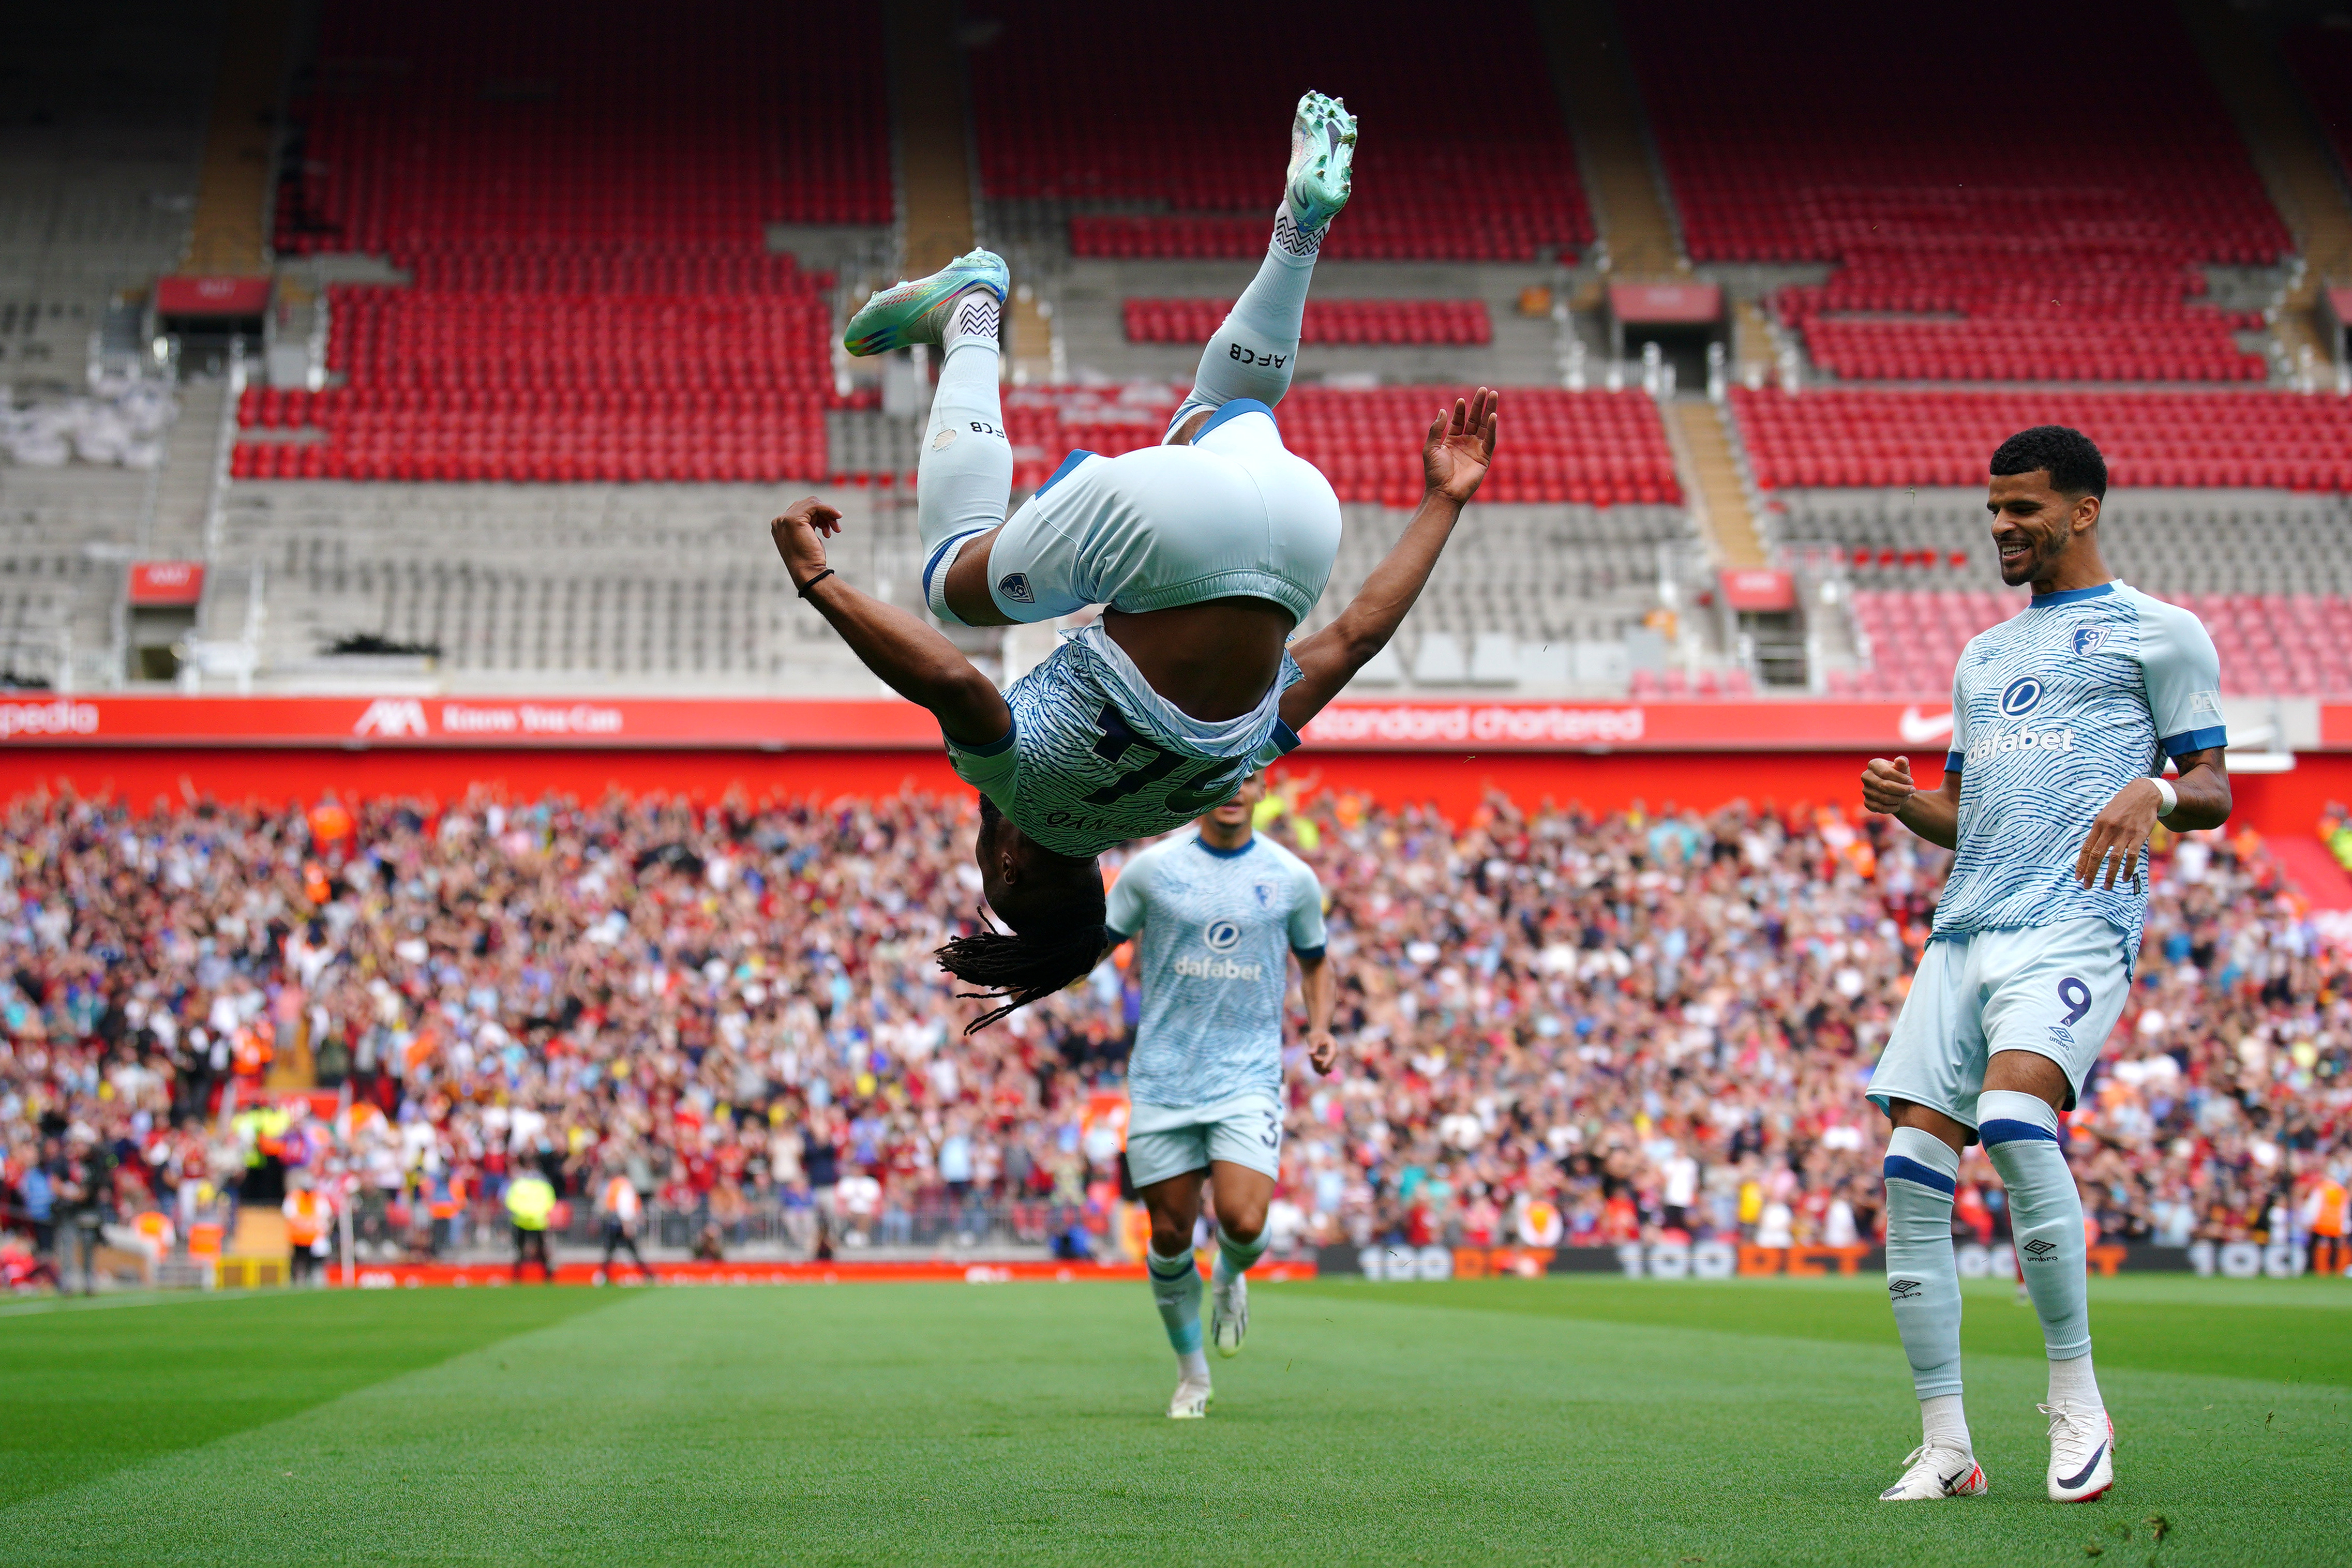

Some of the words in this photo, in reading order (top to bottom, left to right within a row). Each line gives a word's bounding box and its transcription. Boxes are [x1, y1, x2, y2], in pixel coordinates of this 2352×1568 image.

[1230, 343, 1287, 369] AFCB
[1968, 724, 2075, 765] dafabet
[1174, 956, 1262, 981] dafabet
[2057, 977, 2092, 1028] 9
[2049, 1036, 2069, 1051] umbro
[1260, 1110, 1278, 1149] 3
[1892, 1292, 1922, 1301] umbro
